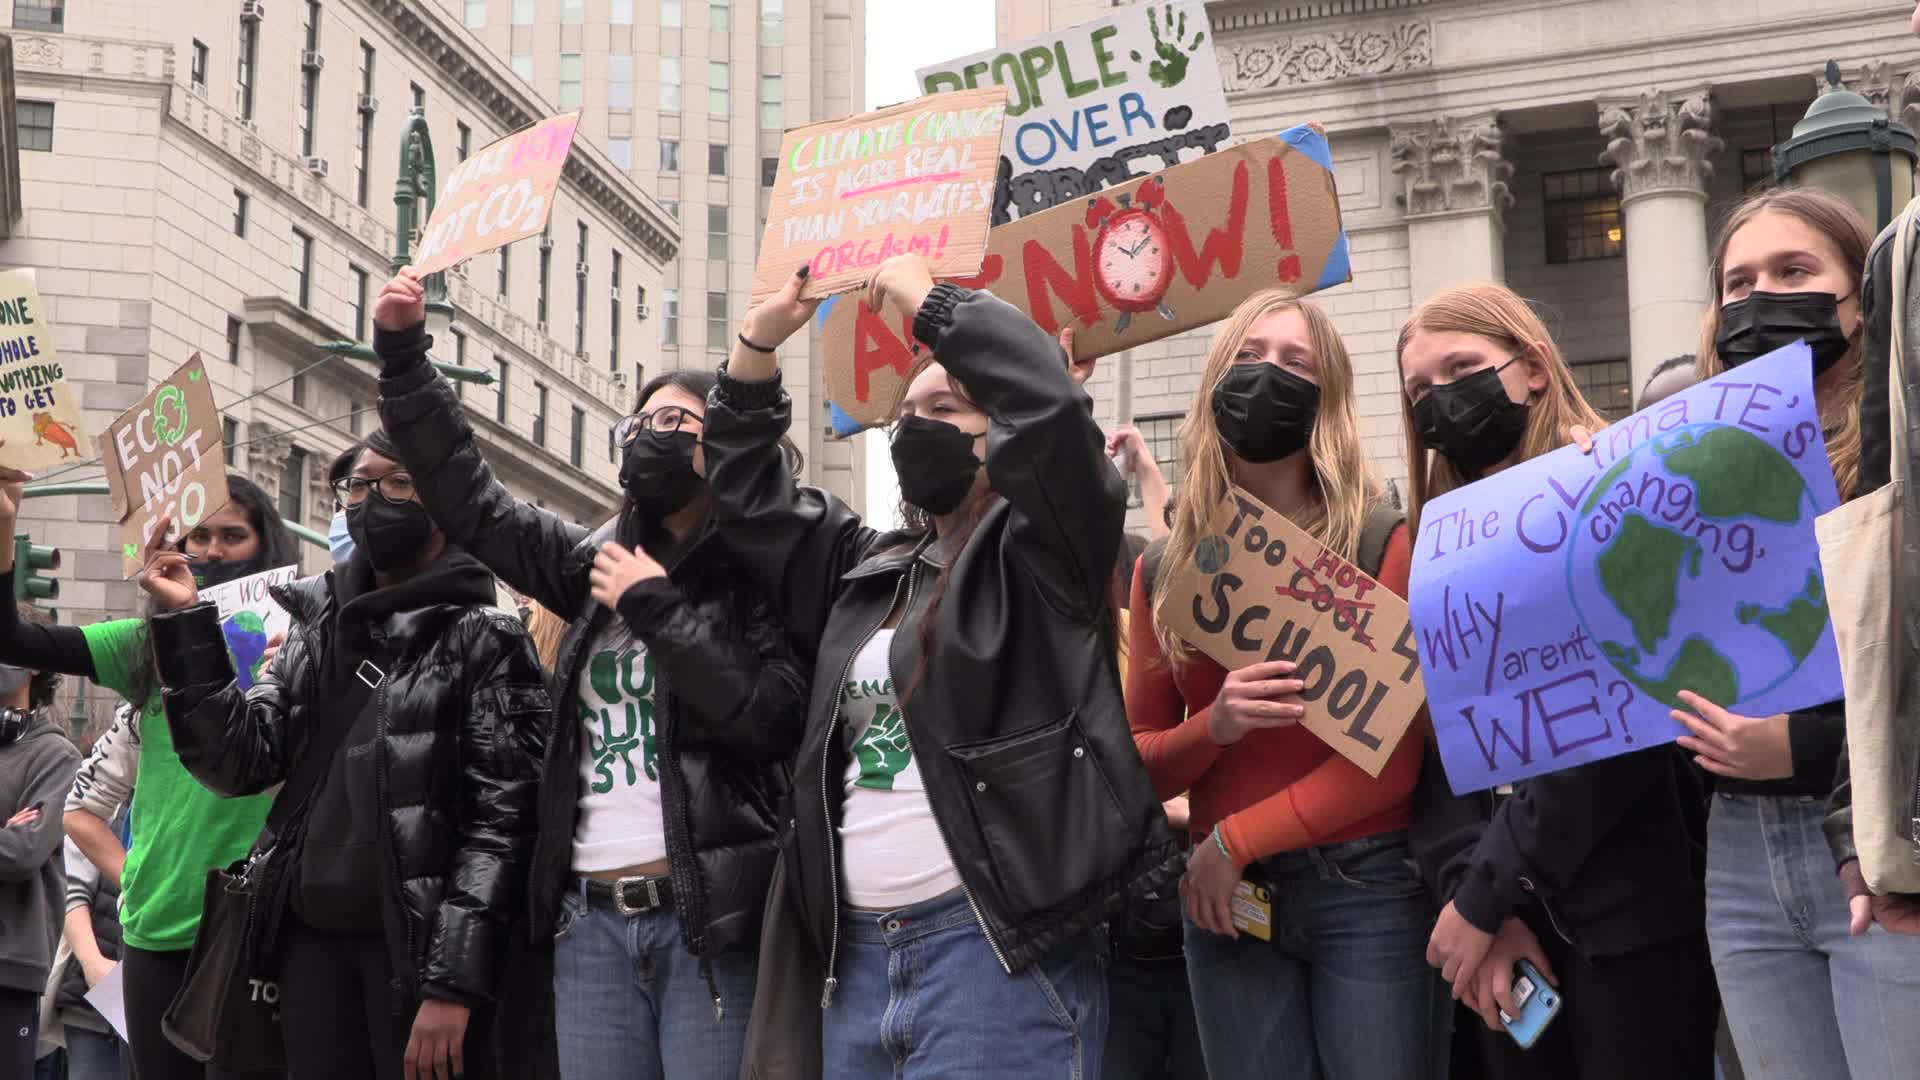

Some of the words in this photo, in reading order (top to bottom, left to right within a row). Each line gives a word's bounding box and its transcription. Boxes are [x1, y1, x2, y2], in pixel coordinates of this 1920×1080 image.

[788, 119, 905, 174] CLIMATE
[904, 103, 1007, 146] CHANGE
[1015, 91, 1156, 166] OVER
[788, 170, 829, 206] IS
[833, 159, 897, 197] MORE
[904, 143, 977, 179] REAL
[783, 208, 846, 249] THAN
[850, 190, 912, 232] YOUR
[0, 335, 40, 366] HOLE
[24, 387, 55, 410] GET
[140, 429, 203, 513] NOT
[1224, 496, 1287, 567] TOO
[1424, 508, 1500, 561] The
[1590, 471, 1766, 574] changing,
[1313, 550, 1376, 600] HOT
[1191, 572, 1391, 752] SCHOOL
[1423, 584, 1504, 696] WHY
[1458, 668, 1636, 773] WE?
